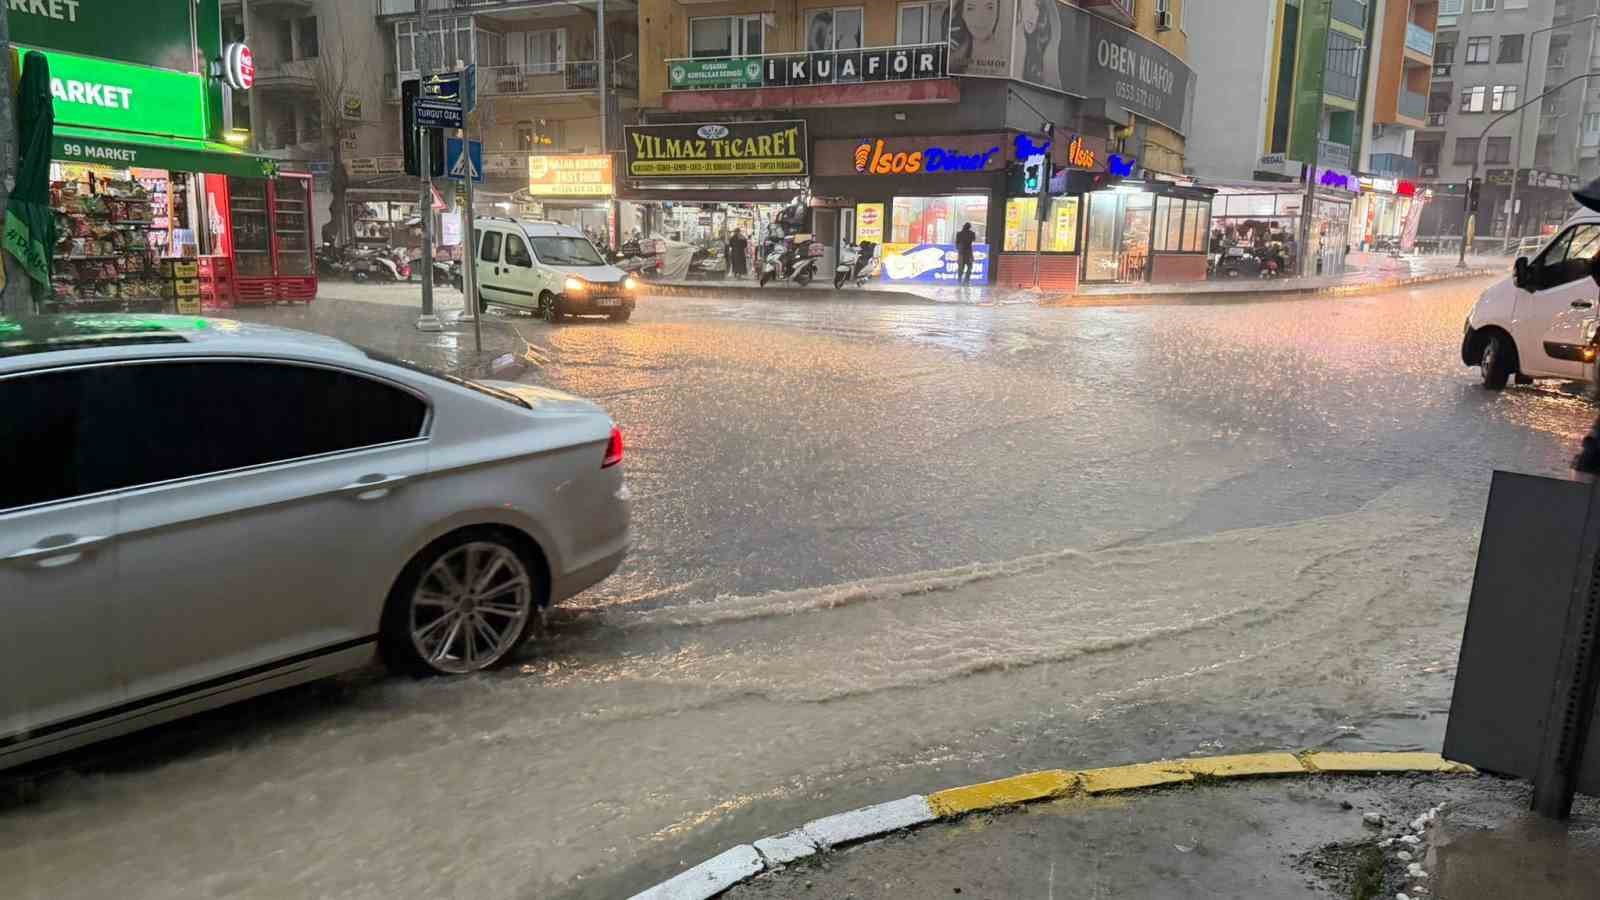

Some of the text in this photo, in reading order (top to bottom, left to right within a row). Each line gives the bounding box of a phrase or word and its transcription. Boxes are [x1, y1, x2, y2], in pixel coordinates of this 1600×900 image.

[7, 0, 79, 22] RKET
[1098, 39, 1137, 78] OBEN
[417, 108, 443, 119] TURGUT
[64, 143, 137, 161] 99 MARKET
[632, 132, 707, 159] YILMAZ
